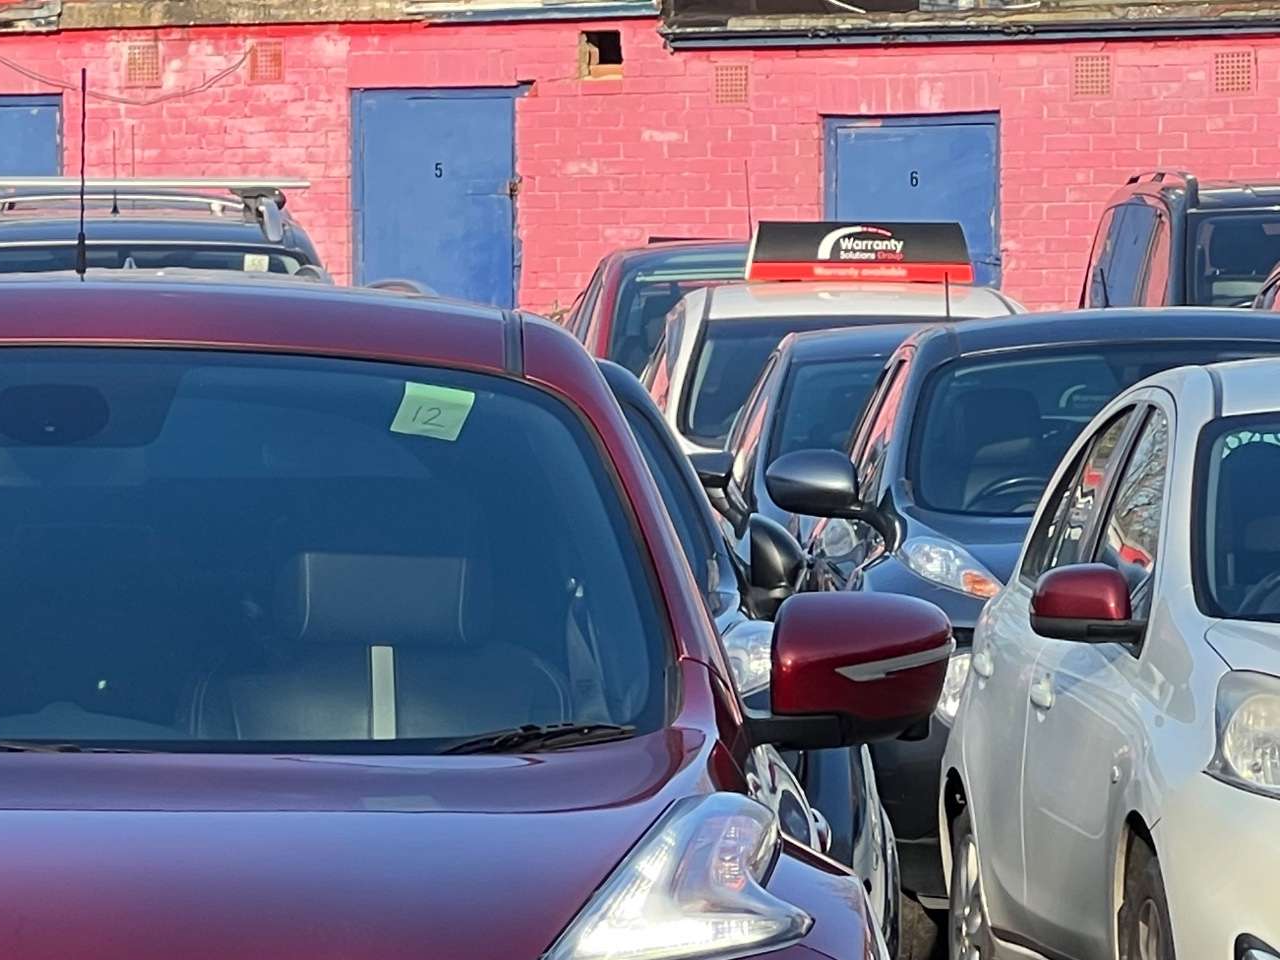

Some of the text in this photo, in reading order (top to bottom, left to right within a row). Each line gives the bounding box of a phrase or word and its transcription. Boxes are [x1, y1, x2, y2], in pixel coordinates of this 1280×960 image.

[434, 162, 443, 178] 5
[910, 170, 919, 188] 6
[840, 237, 904, 253] Warranty
[412, 405, 446, 428] 12
